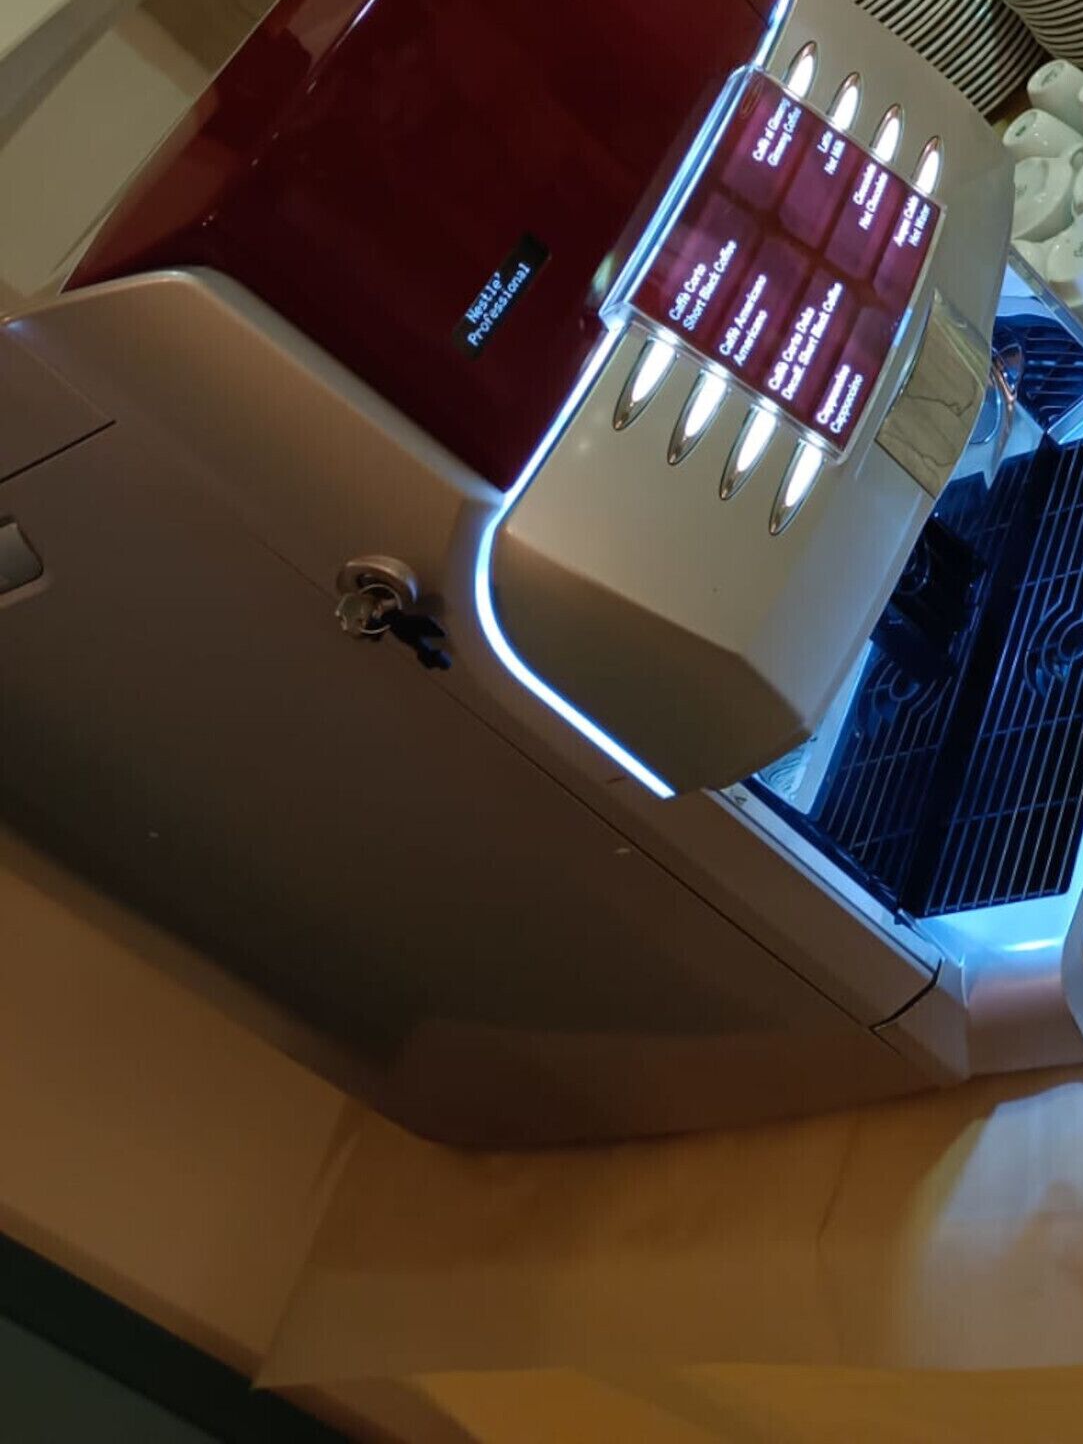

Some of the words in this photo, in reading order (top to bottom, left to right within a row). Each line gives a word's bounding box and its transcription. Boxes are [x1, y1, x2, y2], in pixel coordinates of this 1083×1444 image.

[467, 262, 531, 346] Professional
[683, 298, 706, 331] Short
[698, 271, 721, 301] Black
[713, 240, 737, 273] Coffee
[684, 263, 707, 293] Corto
[734, 274, 767, 329] Americano
[733, 310, 768, 367] Americano
[782, 332, 803, 362] Corto
[798, 336, 819, 366] Short
[810, 312, 830, 339] Black
[822, 282, 843, 313] Coffee
[830, 374, 864, 434] Cappuccino
